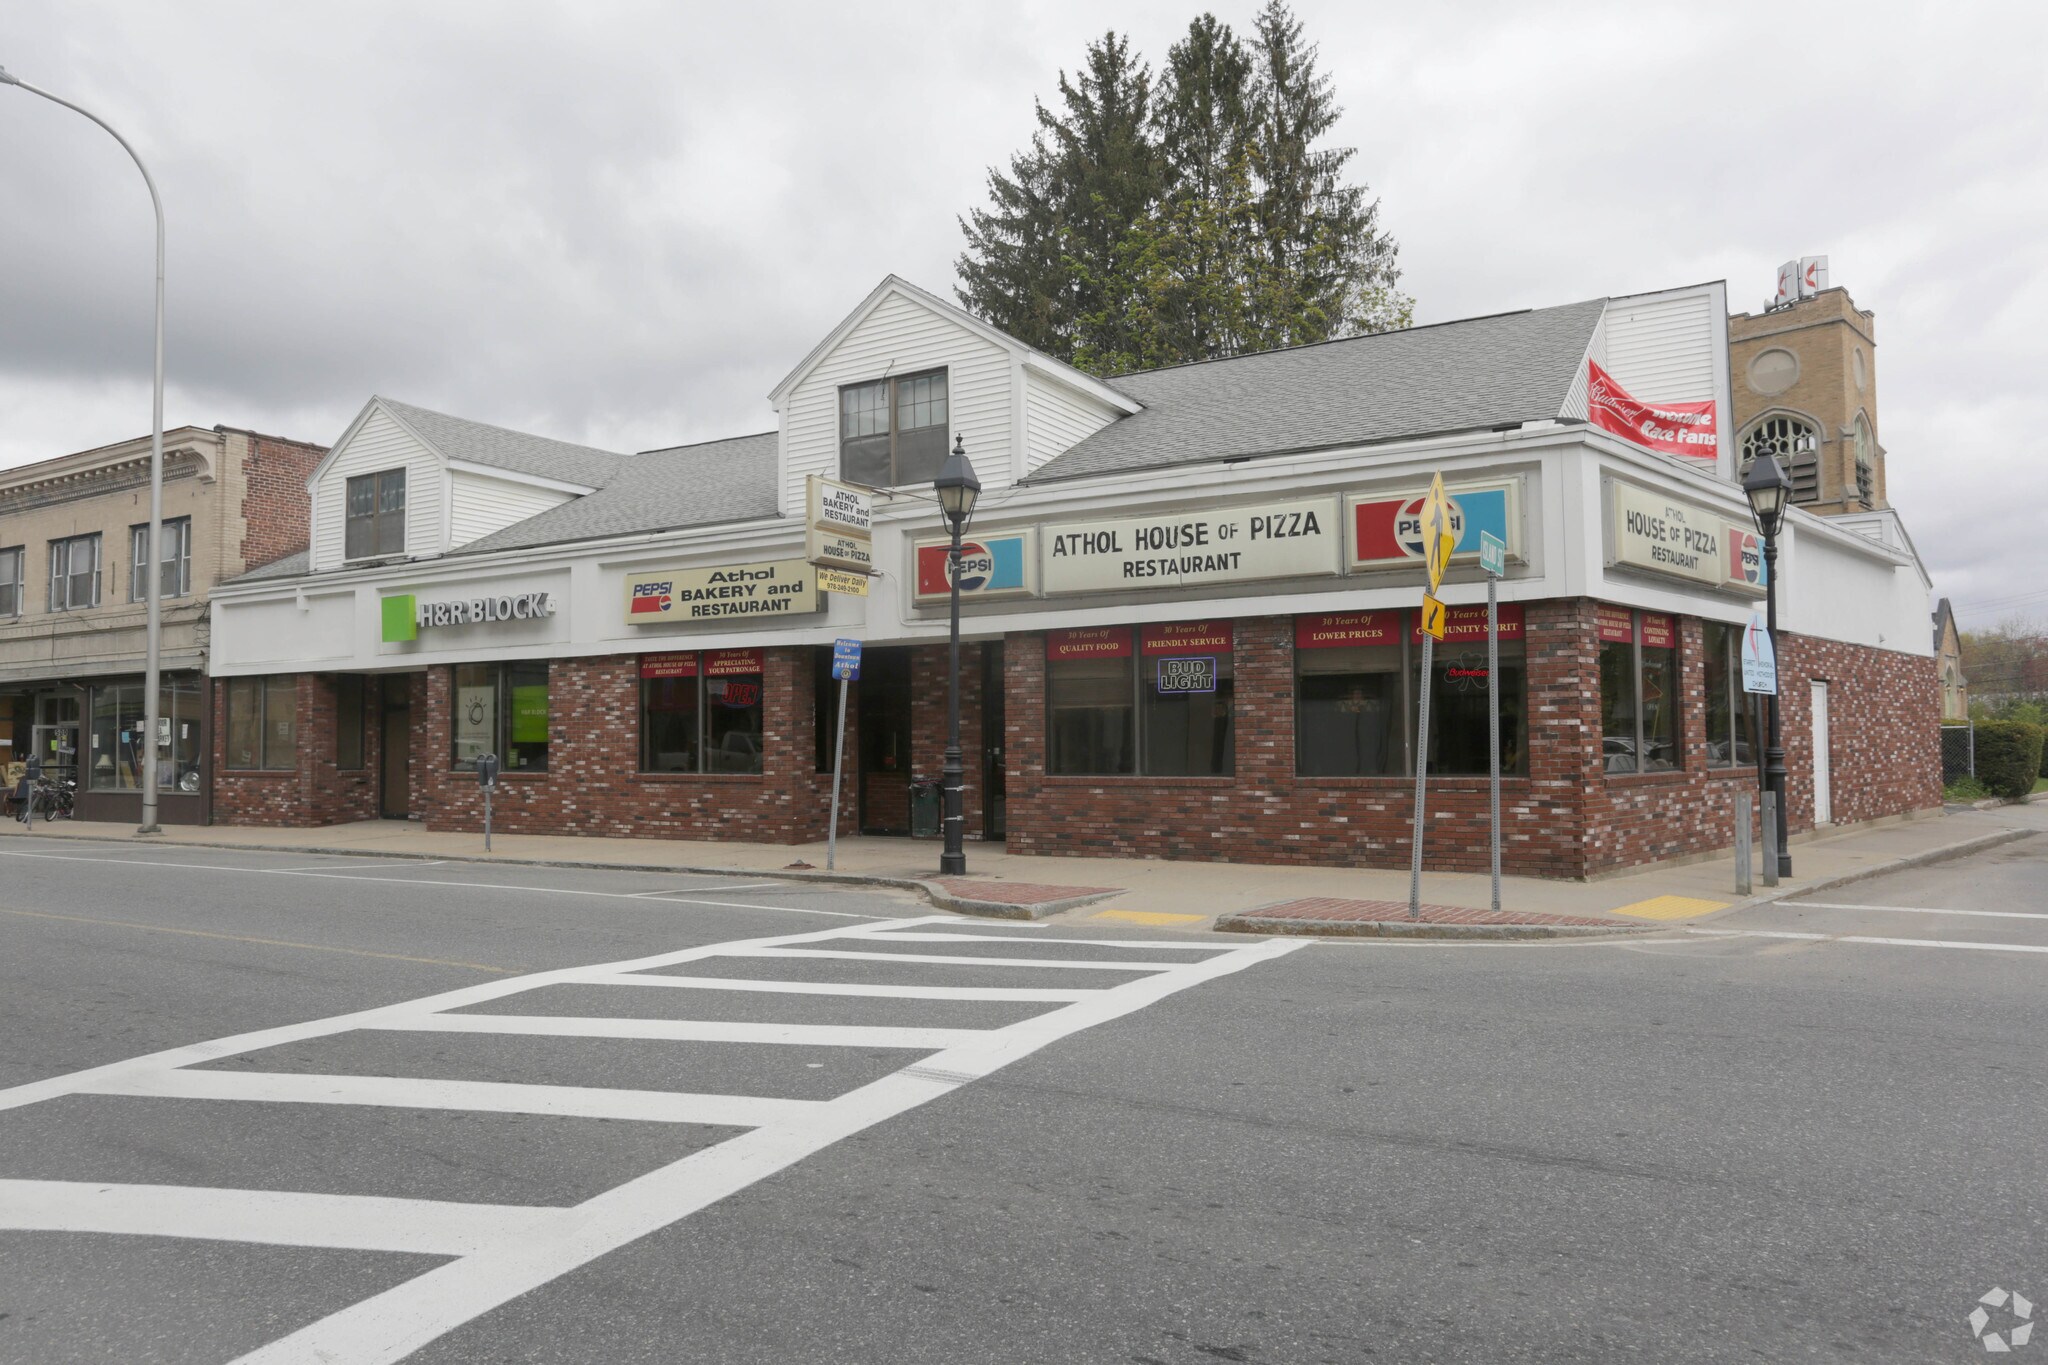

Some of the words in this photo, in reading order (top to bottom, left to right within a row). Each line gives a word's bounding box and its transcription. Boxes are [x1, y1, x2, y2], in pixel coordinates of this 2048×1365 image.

[1641, 420, 1674, 441] Race
[1677, 428, 1716, 445] Fans
[835, 491, 859, 505] ATHOL
[823, 497, 854, 513] BAKERY
[856, 506, 870, 517] and
[1665, 506, 1686, 524] ATHOL
[824, 508, 869, 528] RESTAURANT
[1398, 515, 1461, 535] PEI
[1052, 530, 1123, 558] ATHOL
[1135, 522, 1209, 551] HOUSE
[1217, 522, 1239, 541] OF
[1250, 511, 1321, 541] PIZZA
[1627, 509, 1666, 542] HOUSE
[1670, 526, 1680, 541] OF
[1684, 527, 1717, 557] PIZZA
[837, 539, 857, 550] ATHOL
[823, 545, 844, 558] HOUSE
[850, 550, 871, 562] PIZZA
[1652, 545, 1698, 571] RESTAURANT
[1741, 550, 1759, 566] PEPSI
[1123, 551, 1242, 579] RESTAURANT
[708, 567, 775, 584] Athol
[819, 571, 828, 580] We
[829, 573, 850, 584] Deliver
[851, 576, 867, 588] Daily
[633, 581, 673, 597] PEPSI
[681, 584, 757, 602] BAKERY
[767, 580, 803, 595] and
[420, 600, 465, 628] H&R
[470, 592, 548, 623] BLOCK
[692, 598, 791, 617] RESTAURANT
[1453, 610, 1478, 618] Years
[1481, 609, 1489, 617] O
[1322, 617, 1333, 626] 30
[1335, 617, 1358, 625] Years
[1361, 615, 1373, 625] Of
[1483, 623, 1518, 632] SIRIT
[1100, 629, 1110, 639] Of
[1163, 625, 1172, 634] 30
[1175, 625, 1195, 633] Years
[1198, 624, 1208, 634] Of
[1312, 631, 1346, 640] LOWER
[1348, 629, 1383, 639] PRICES
[836, 640, 860, 648] Welcome
[1059, 643, 1094, 654] QUALITY
[1096, 642, 1119, 651] FOOD
[1147, 639, 1189, 648] FRIENDLY
[1189, 637, 1226, 646] SERVICE
[742, 650, 749, 658] Of
[712, 658, 756, 667] APPRECIATING
[725, 665, 761, 674] PATRONAGE
[835, 661, 859, 669] Athol
[1168, 660, 1206, 675] BUD
[1161, 674, 1213, 690] LIGHT
[722, 683, 758, 704] OPEN
